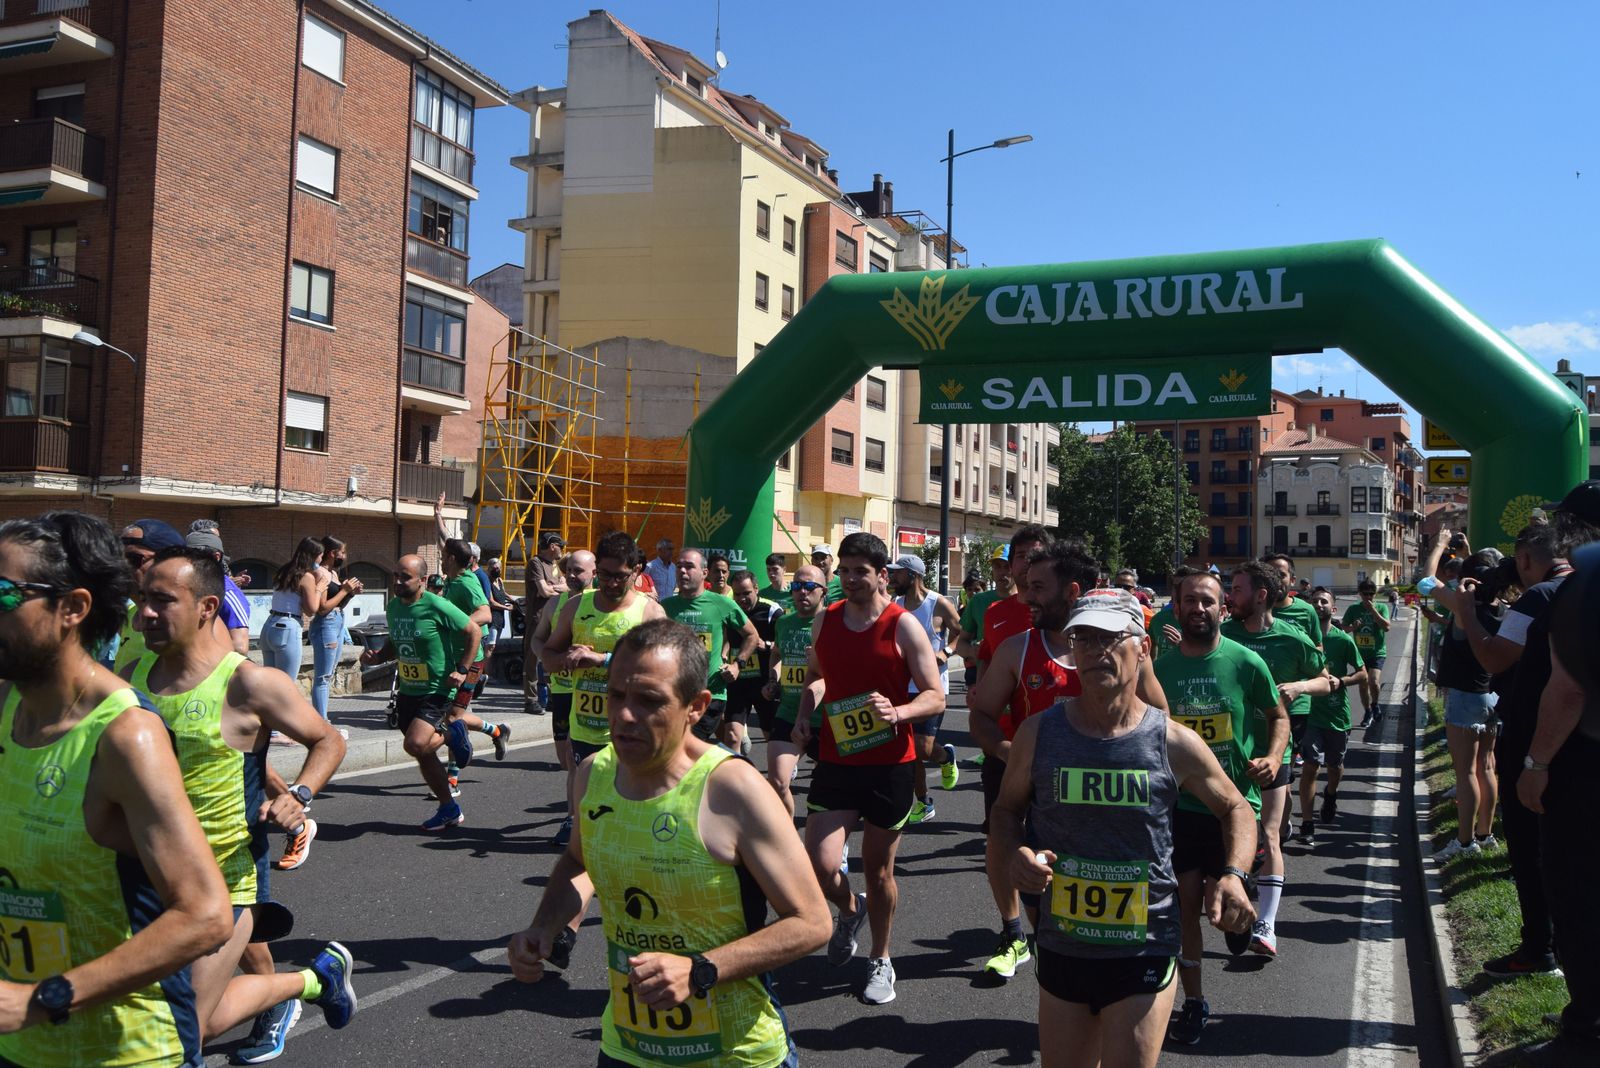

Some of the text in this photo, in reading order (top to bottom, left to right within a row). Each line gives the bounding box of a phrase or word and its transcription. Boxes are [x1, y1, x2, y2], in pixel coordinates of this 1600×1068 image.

[985, 267, 1304, 326] CAJA RURAL
[981, 372, 1199, 410] SALIDA
[1208, 393, 1257, 403] CAJA RURAL
[931, 402, 973, 410] CAJA RURAL
[402, 665, 420, 679] 93
[786, 668, 805, 684] 40
[580, 693, 608, 715] 20
[843, 710, 874, 736] 99
[1184, 719, 1217, 740] 75
[1211, 744, 1232, 753] URAL
[1061, 770, 1150, 803] I RUN
[1080, 862, 1136, 874] FUNDACION
[1080, 870, 1136, 881] CAJA RURAL
[0, 893, 46, 908] DACION
[1063, 882, 1135, 920] 197
[615, 924, 688, 950] Adarsa
[1076, 927, 1102, 938] CAJA
[638, 1040, 715, 1058] CAJA RURAL
